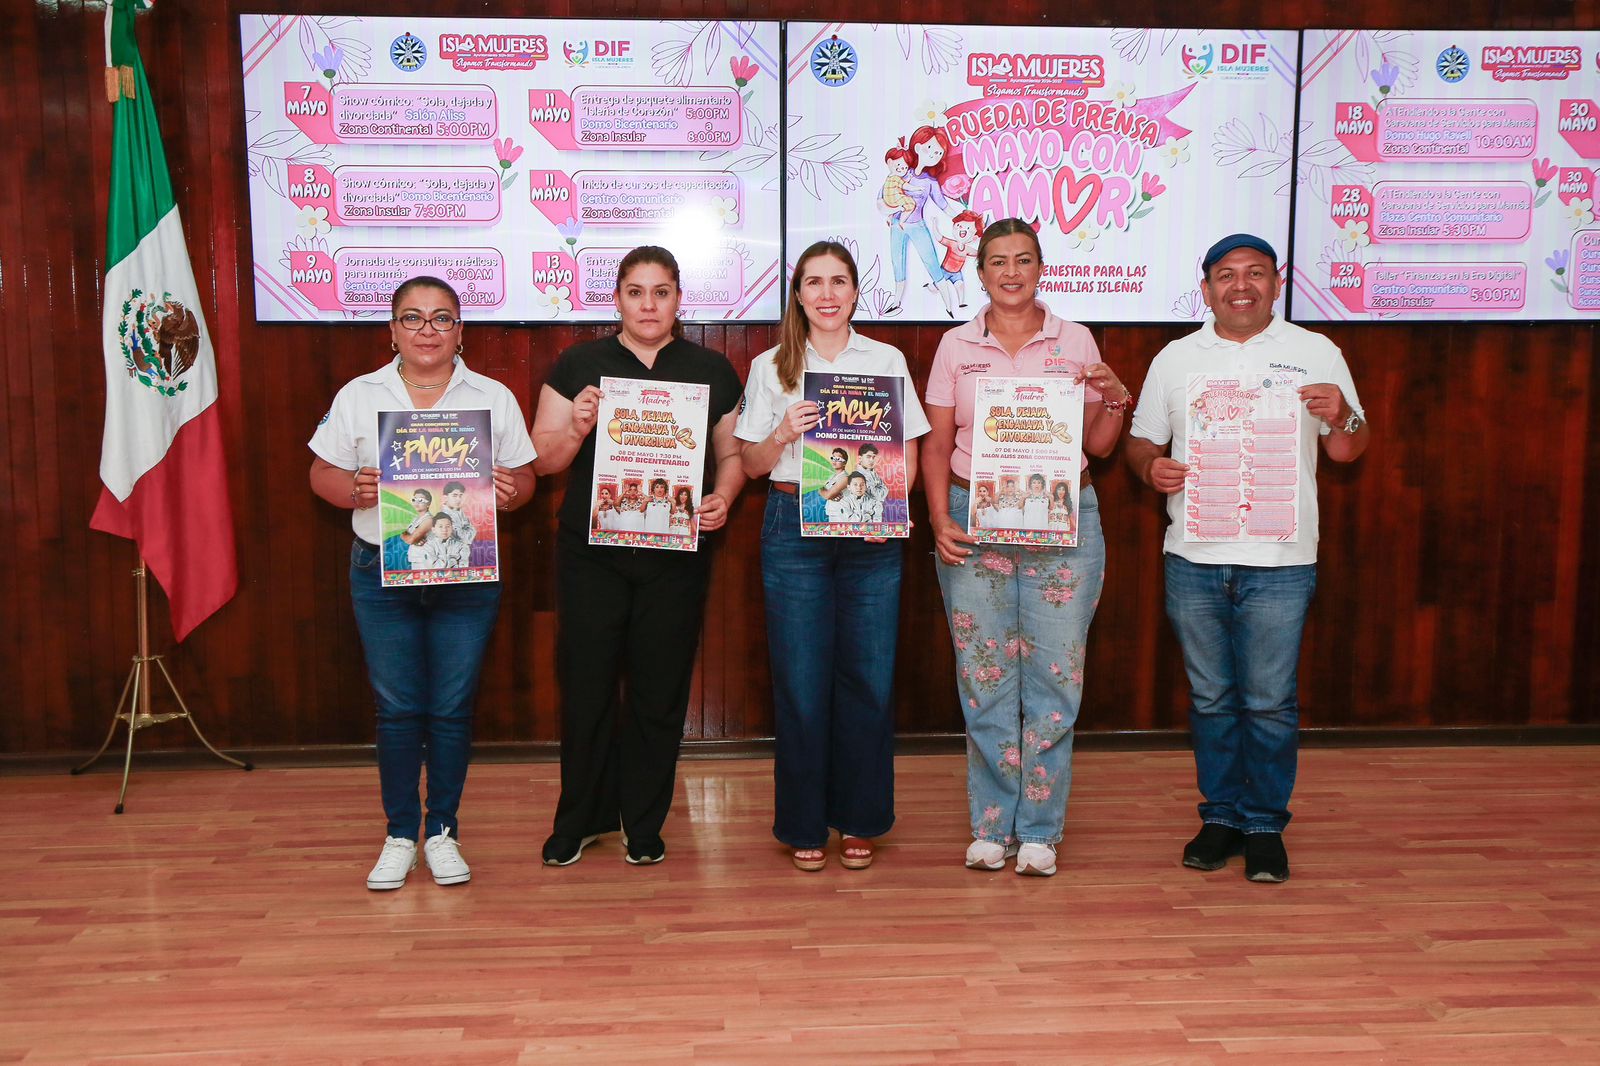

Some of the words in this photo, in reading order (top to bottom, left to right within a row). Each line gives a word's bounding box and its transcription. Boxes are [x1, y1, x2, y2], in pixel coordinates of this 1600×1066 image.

[442, 37, 475, 53] ISLA
[479, 37, 545, 53] MUJERES
[594, 40, 631, 56] DIF
[1222, 44, 1266, 64] DIF
[1486, 49, 1514, 64] ISLA
[1518, 50, 1579, 64] MUJERES
[456, 58, 484, 68] Sigamos
[485, 58, 533, 68] Transformando
[972, 57, 1013, 77] ISLA
[1017, 58, 1100, 78] MUJERES
[301, 86, 312, 100] 7
[987, 84, 1022, 97] Sigamos
[1024, 84, 1085, 96] Transformando
[340, 95, 369, 107] Show
[450, 95, 484, 109] dejada
[486, 98, 492, 109] y
[545, 93, 556, 106] 11
[580, 94, 620, 106] Entrega
[622, 94, 634, 104] de
[636, 96, 674, 107] paquete
[676, 94, 732, 106] alimentario
[287, 100, 328, 116] MAYO
[616, 106, 628, 116] de
[686, 108, 730, 120] 5:00PM
[1349, 106, 1362, 120] 18
[1570, 102, 1589, 117] 30
[405, 109, 437, 121] Salón
[439, 109, 465, 121] Aliss
[531, 108, 572, 122] MAYO
[340, 123, 369, 135] Zona
[370, 123, 432, 135] Continental
[436, 122, 490, 136] 5:00PM
[581, 118, 612, 130] Domo
[614, 118, 678, 130] Bicentenario
[946, 101, 1027, 146] RUEDA
[1034, 100, 1065, 124] DE
[1072, 101, 1161, 147] PRENSA
[1336, 120, 1374, 134] MAYO
[1386, 119, 1427, 128] Caravana
[1428, 119, 1440, 128] de
[1442, 119, 1481, 128] Servicios
[1482, 120, 1501, 128] para
[1504, 118, 1536, 128] Mamás
[1560, 117, 1597, 132] MAYO
[581, 131, 610, 142] Zona
[611, 131, 646, 142] Insular
[687, 131, 731, 142] 8:00PM
[1385, 130, 1414, 140] Domo
[1418, 130, 1442, 141] Hugo
[1384, 144, 1410, 154] Zona
[1412, 144, 1469, 154] Continental
[1475, 136, 1532, 148] 10:00AM
[965, 131, 1062, 177] MAYO
[1072, 131, 1143, 177] CON
[304, 168, 315, 183] 8
[545, 174, 554, 186] 11
[1568, 171, 1582, 182] 30
[290, 183, 331, 198] MAYO
[342, 178, 371, 189] Show
[453, 178, 487, 192] dejada
[488, 181, 494, 192] y
[582, 180, 608, 190] Inicio
[610, 180, 622, 190] de
[625, 181, 659, 190] cursos
[660, 180, 672, 190] de
[674, 180, 737, 192] capacitación
[1560, 182, 1588, 193] MAYO
[402, 192, 432, 202] Domo
[434, 192, 494, 202] Bicentenario
[531, 187, 570, 202] MAYO
[582, 194, 618, 204] Centro
[620, 194, 684, 204] Comunitario
[1343, 188, 1361, 202] 28
[344, 206, 373, 216] Zona
[375, 206, 411, 216] Insular
[415, 204, 466, 218] 7:30PM
[582, 208, 611, 218] Zona
[612, 208, 674, 218] Continental
[1332, 202, 1370, 218] MAYO
[1380, 212, 1406, 222] Plaza
[1408, 212, 1442, 222] Centro
[1444, 212, 1502, 222] Comunitario
[1379, 225, 1406, 236] Zona
[1408, 225, 1440, 236] Insular
[1442, 224, 1486, 236] 5:30PM
[306, 255, 317, 269] 9
[344, 256, 386, 268] Jornada
[387, 256, 400, 267] de
[402, 257, 452, 268] consultas
[454, 257, 498, 268] médicas
[546, 256, 560, 269] 13
[292, 269, 332, 284] MAYO
[344, 270, 366, 280] para
[368, 269, 407, 279] mamás
[446, 269, 494, 281] 9:00AM
[1041, 265, 1091, 277] ENESTAR
[1094, 265, 1122, 277] PARA
[1127, 265, 1147, 277] LAS
[1339, 265, 1354, 276] 29
[1375, 270, 1398, 280] Taller
[1462, 270, 1470, 280] la
[1472, 271, 1486, 280] Era
[534, 270, 572, 284] MAYO
[1330, 276, 1362, 288] MAYO
[1040, 281, 1094, 293] FAMILIAS
[1097, 279, 1144, 293] ISLEÑAS
[1372, 284, 1406, 294] Centro
[1408, 284, 1468, 294] Comunitario
[1471, 288, 1520, 300] 5:00PM
[345, 292, 374, 303] Zona
[586, 292, 613, 302] Zona
[687, 290, 729, 302] 5:30PM
[1372, 296, 1400, 306] Zona
[1401, 296, 1435, 306] Insular
[1044, 358, 1065, 366] DIF
[640, 396, 670, 406] Madres
[1014, 392, 1044, 402] Madres
[671, 425, 679, 436] Y
[624, 434, 676, 448] DIVORCIADA
[840, 434, 892, 442] BICENTENARIO
[1000, 432, 1052, 444] DIVORCIADA
[635, 456, 690, 466] BICENTENARIO
[420, 472, 480, 480] BICENTENARIO
